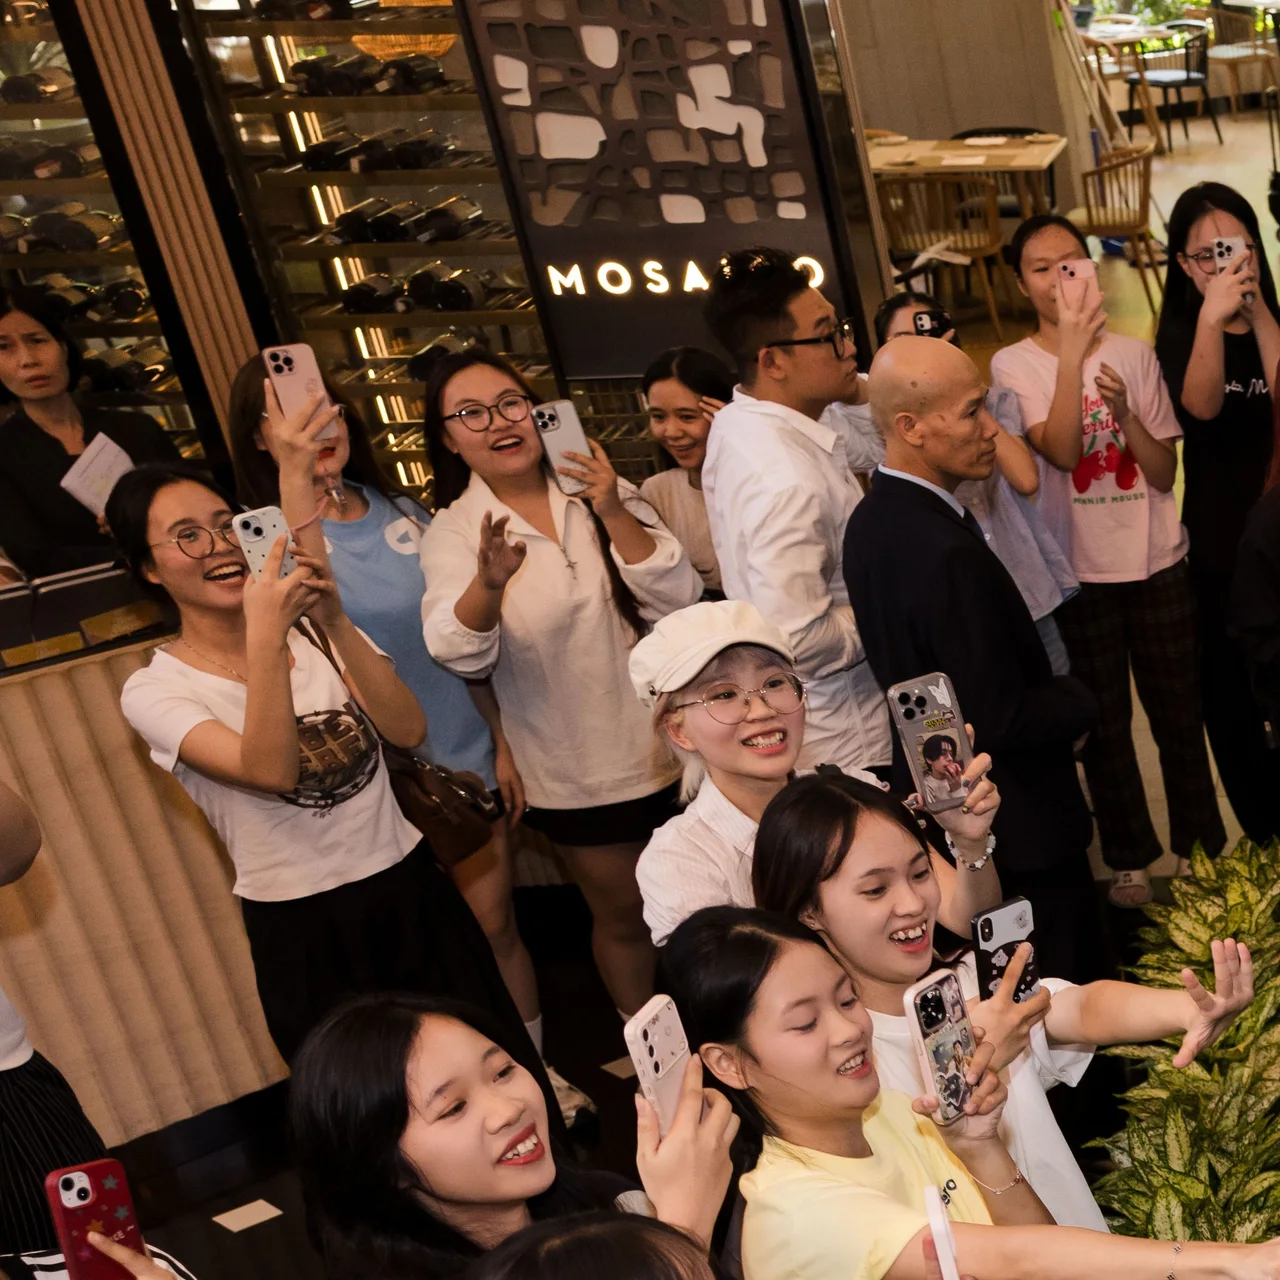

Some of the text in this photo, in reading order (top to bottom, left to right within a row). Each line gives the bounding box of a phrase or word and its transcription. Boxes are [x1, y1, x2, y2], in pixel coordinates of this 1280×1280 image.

[547, 255, 824, 296] MOSAO
[1111, 492, 1145, 504] MOUSE
[941, 1178, 957, 1206] ero
